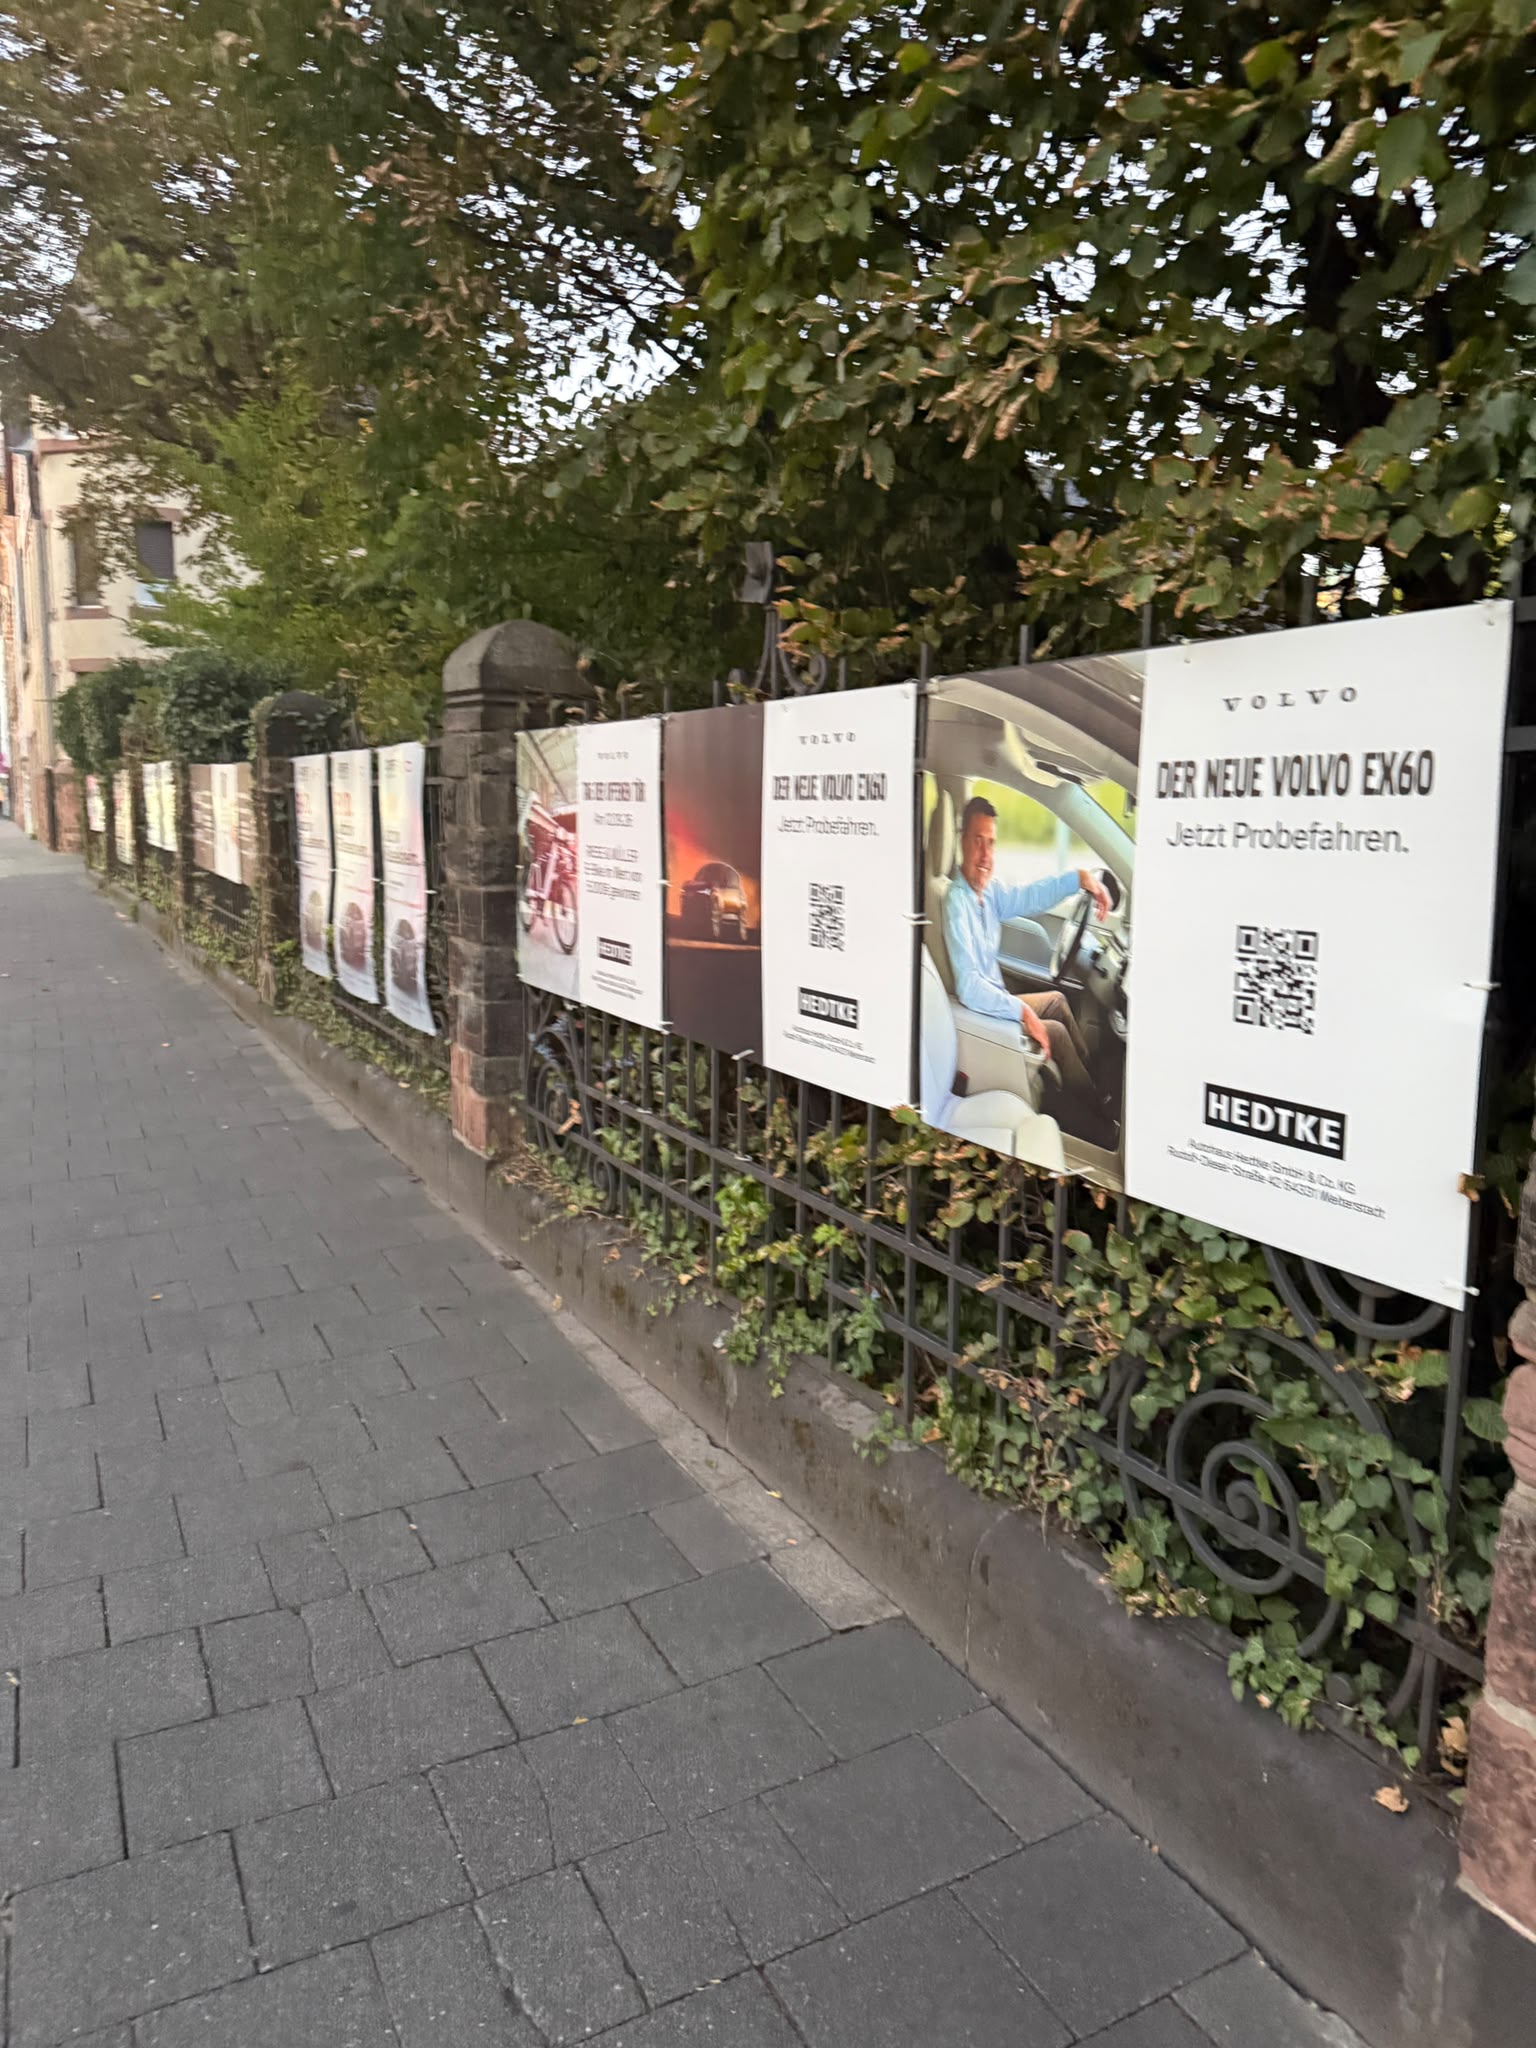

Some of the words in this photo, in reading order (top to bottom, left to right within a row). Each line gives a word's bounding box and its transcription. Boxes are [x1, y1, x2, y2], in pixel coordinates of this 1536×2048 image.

[1222, 687, 1358, 711] VOLVO
[799, 731, 857, 745] VOLVO
[1157, 761, 1197, 798] DER
[1204, 757, 1265, 798] NEUE
[1272, 753, 1351, 797] VOLVO
[1361, 750, 1434, 796] EX60
[1167, 822, 1228, 848] Jetzt
[1233, 822, 1409, 853] Probefahren.
[799, 991, 858, 1022] HEDTKE
[1208, 1091, 1342, 1151] HEDTKE
